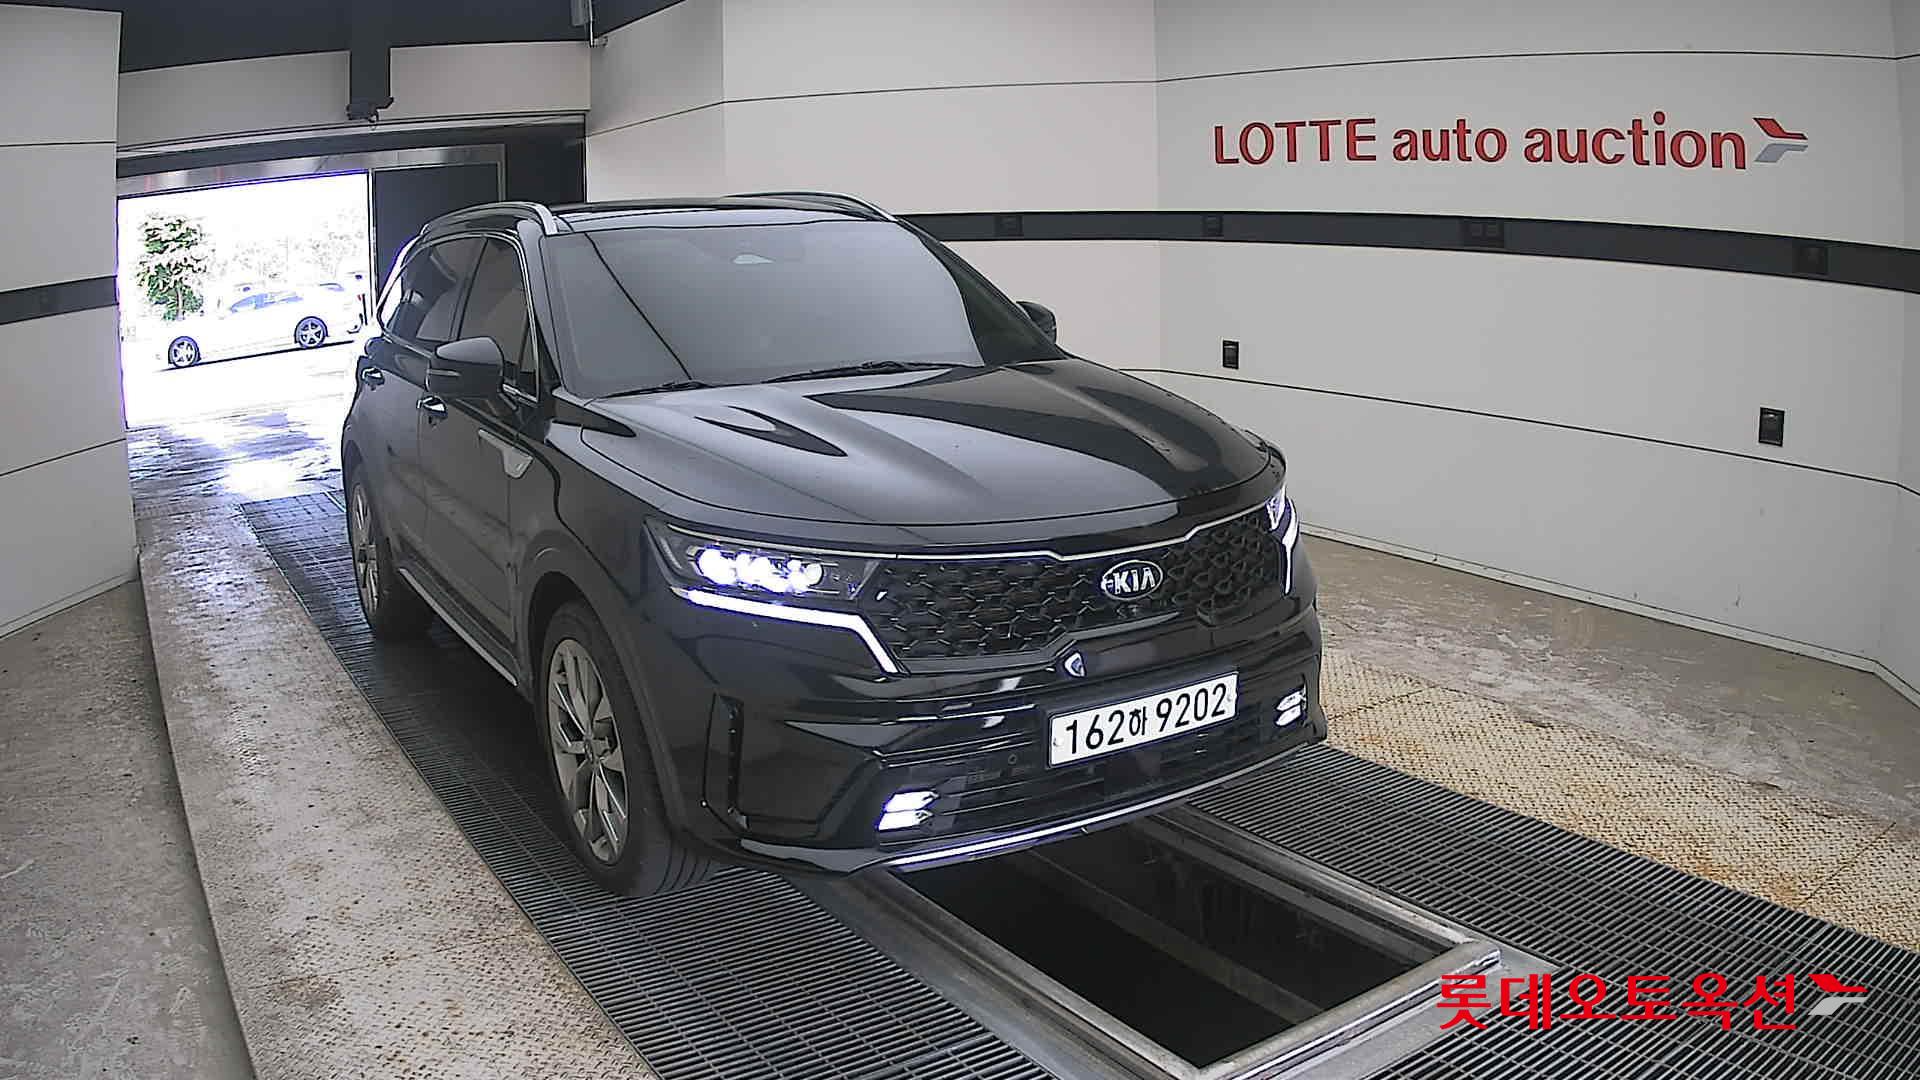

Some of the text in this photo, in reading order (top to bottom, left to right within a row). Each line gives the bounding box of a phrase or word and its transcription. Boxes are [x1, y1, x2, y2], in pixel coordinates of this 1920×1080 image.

[1214, 111, 1747, 170] LOTTE auto auction
[1112, 566, 1157, 595] KIA
